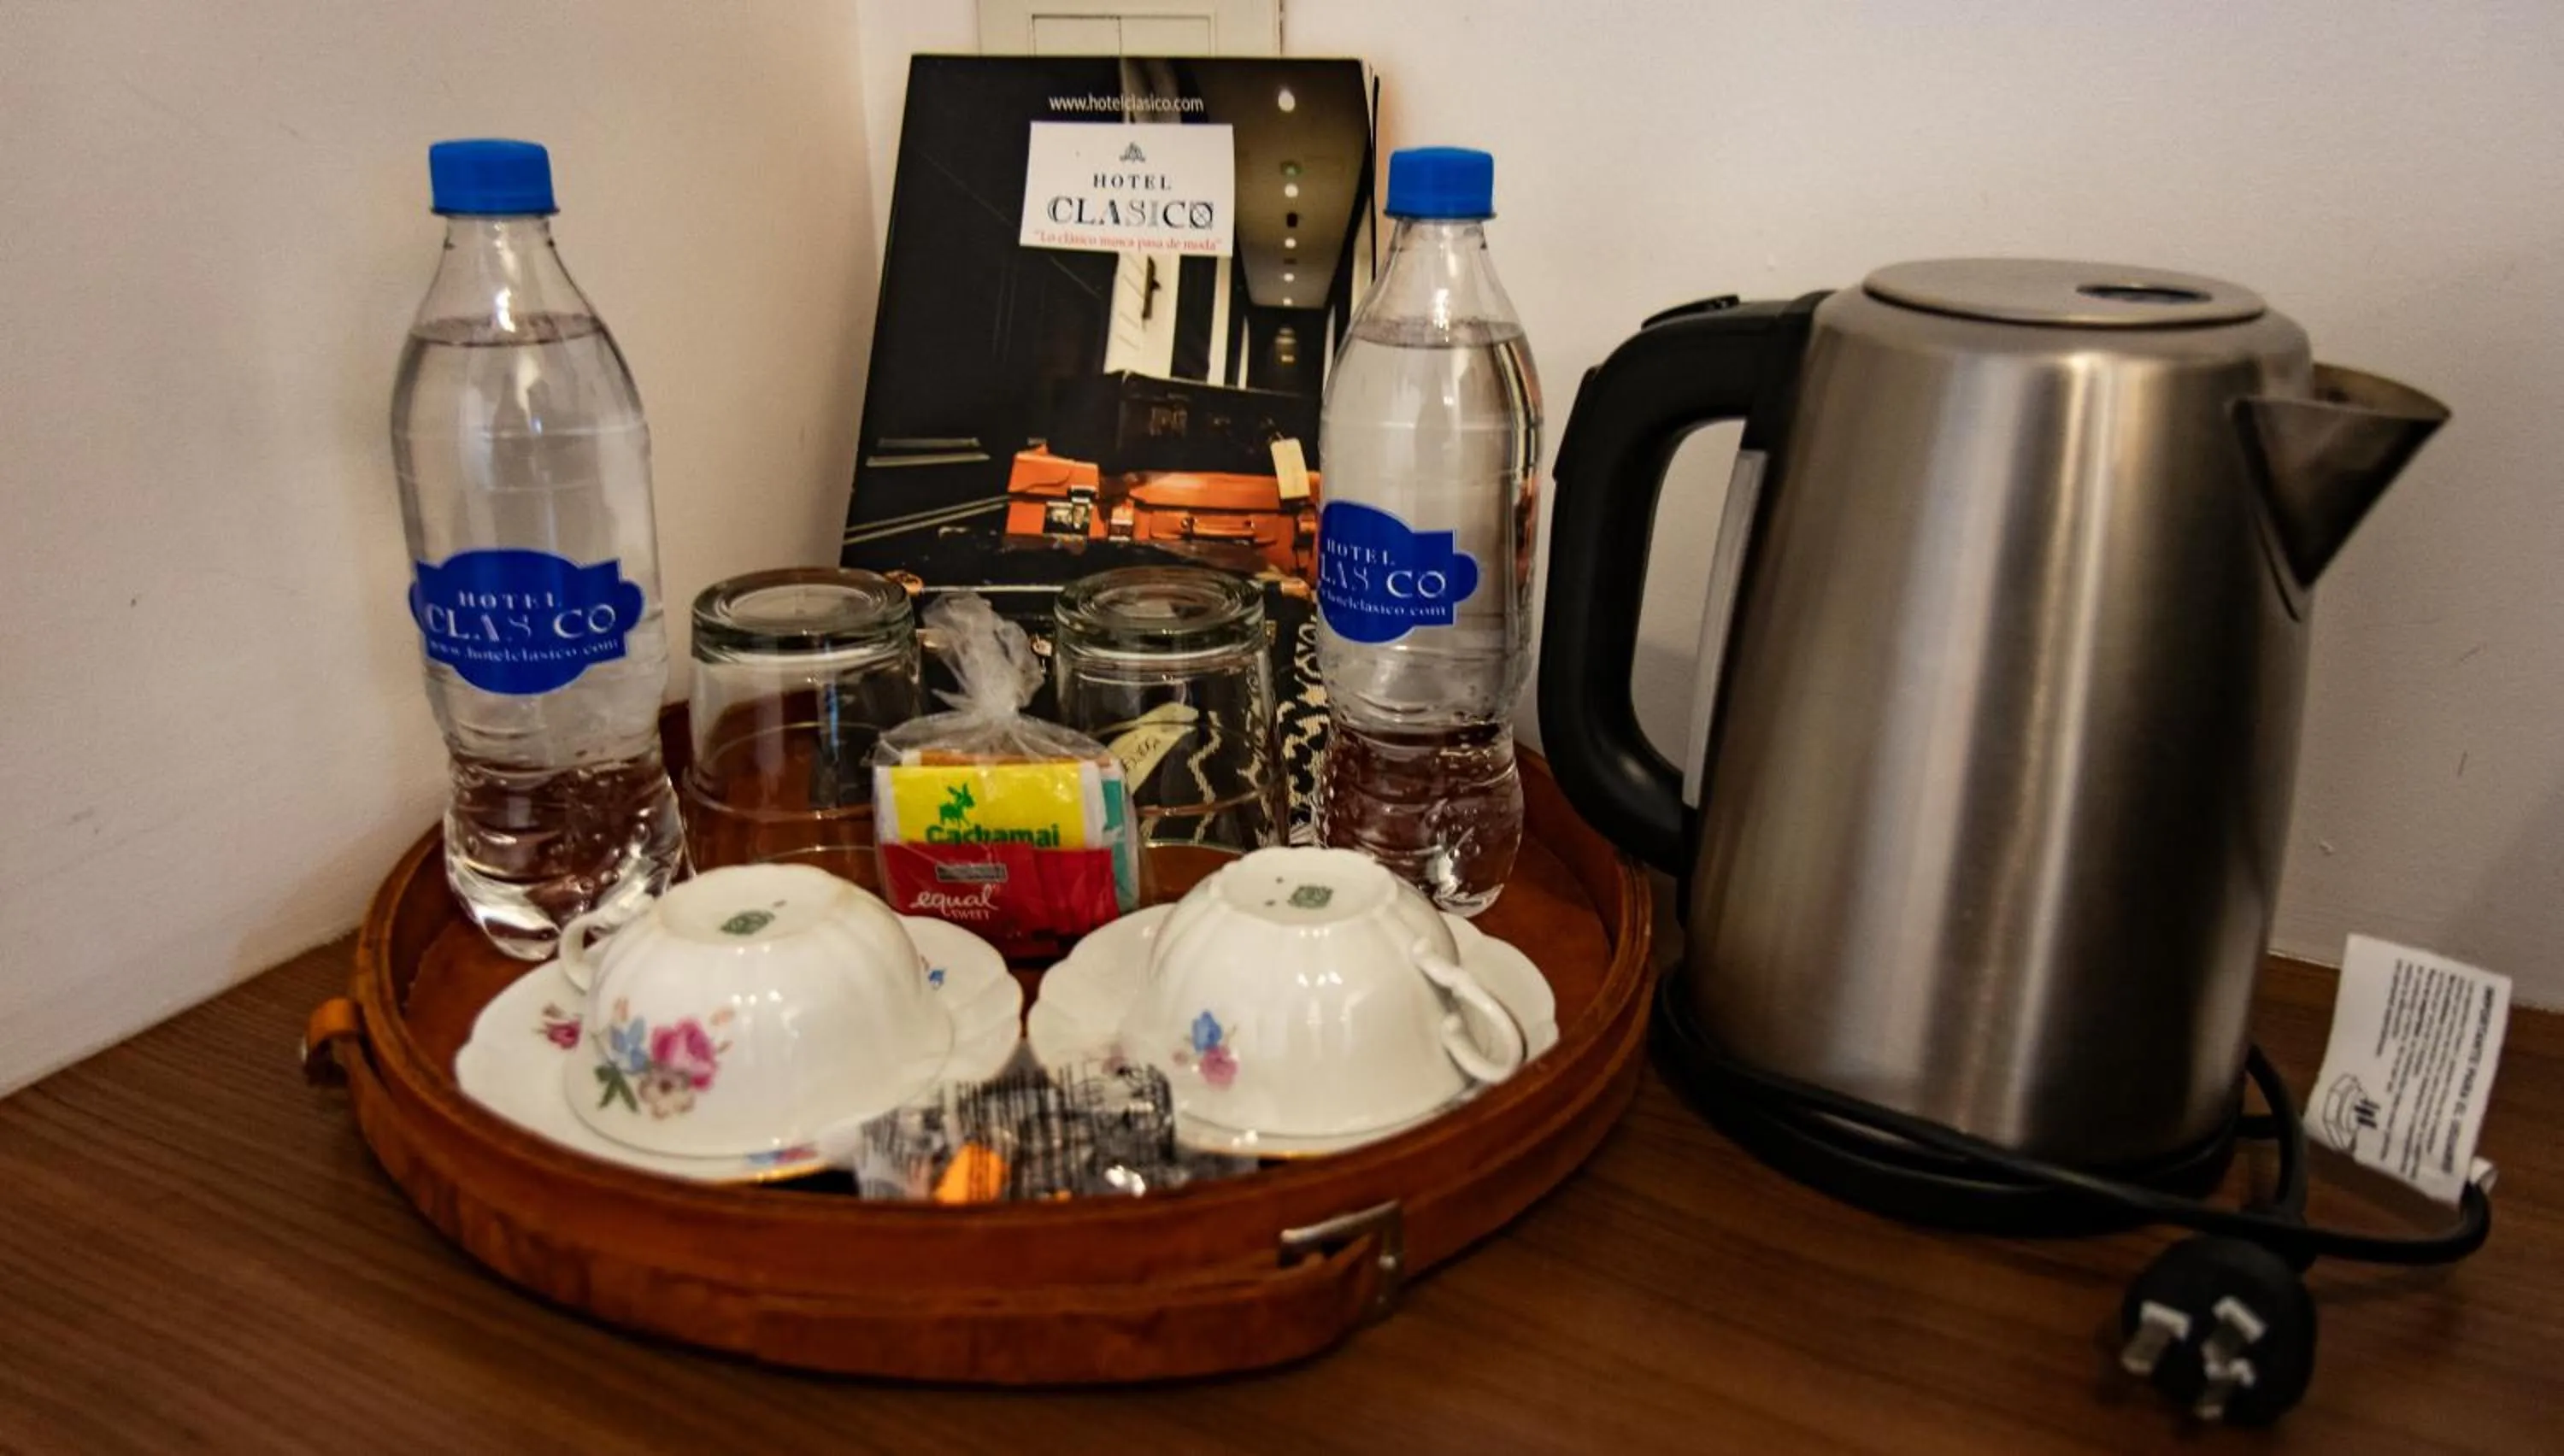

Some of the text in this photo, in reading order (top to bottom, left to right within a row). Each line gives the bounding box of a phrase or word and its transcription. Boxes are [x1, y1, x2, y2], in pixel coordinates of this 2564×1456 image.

[1049, 92, 1204, 113] www.hotelclasico.com
[1093, 173, 1172, 191] HOTEL
[1047, 196, 1214, 231] CLASICO
[1326, 537, 1396, 566] HOTEL
[459, 590, 562, 609] HOTEL
[926, 823, 1061, 847] Cachamai
[909, 883, 999, 917] equal
[951, 908, 990, 920] SWEET
